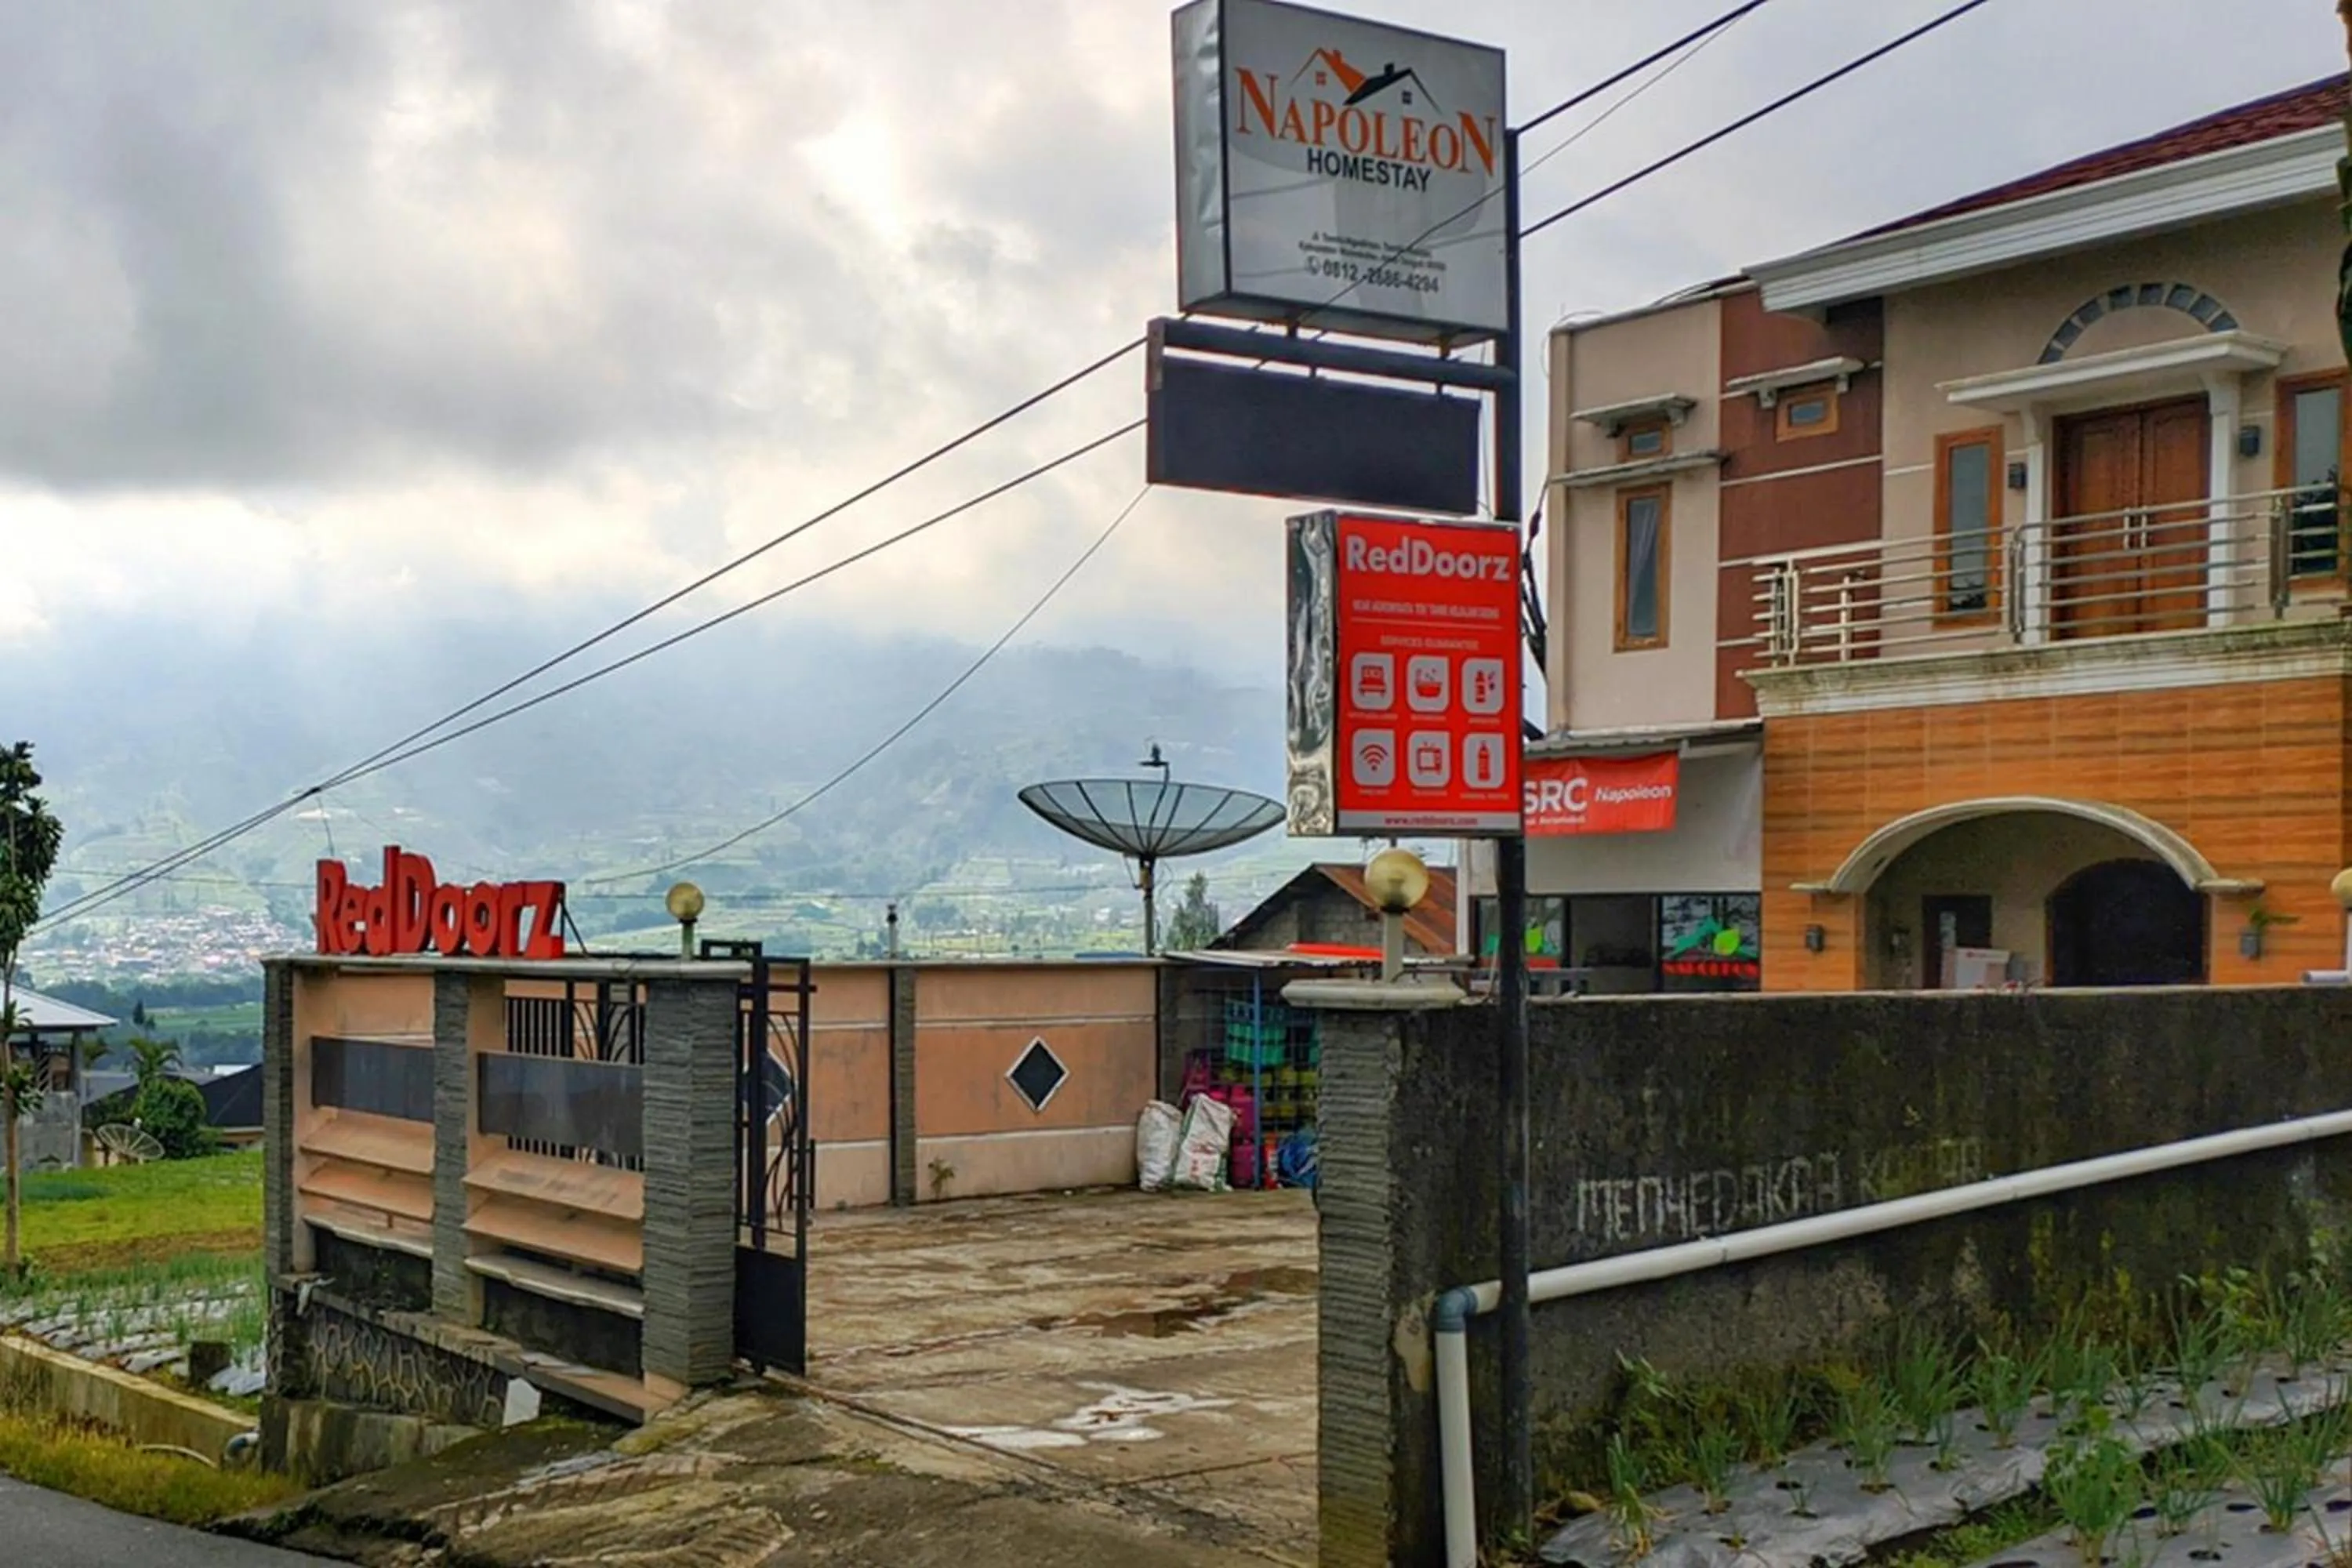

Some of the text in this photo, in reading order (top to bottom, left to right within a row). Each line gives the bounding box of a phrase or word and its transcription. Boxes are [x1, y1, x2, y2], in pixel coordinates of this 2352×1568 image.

[1235, 67, 1497, 177] NAPOLEON
[1307, 147, 1432, 193] HOMESTAY
[1345, 534, 1511, 581] RedDoorz
[1523, 777, 1672, 815] SRC Napoleon
[316, 844, 565, 960] RedDoorz
